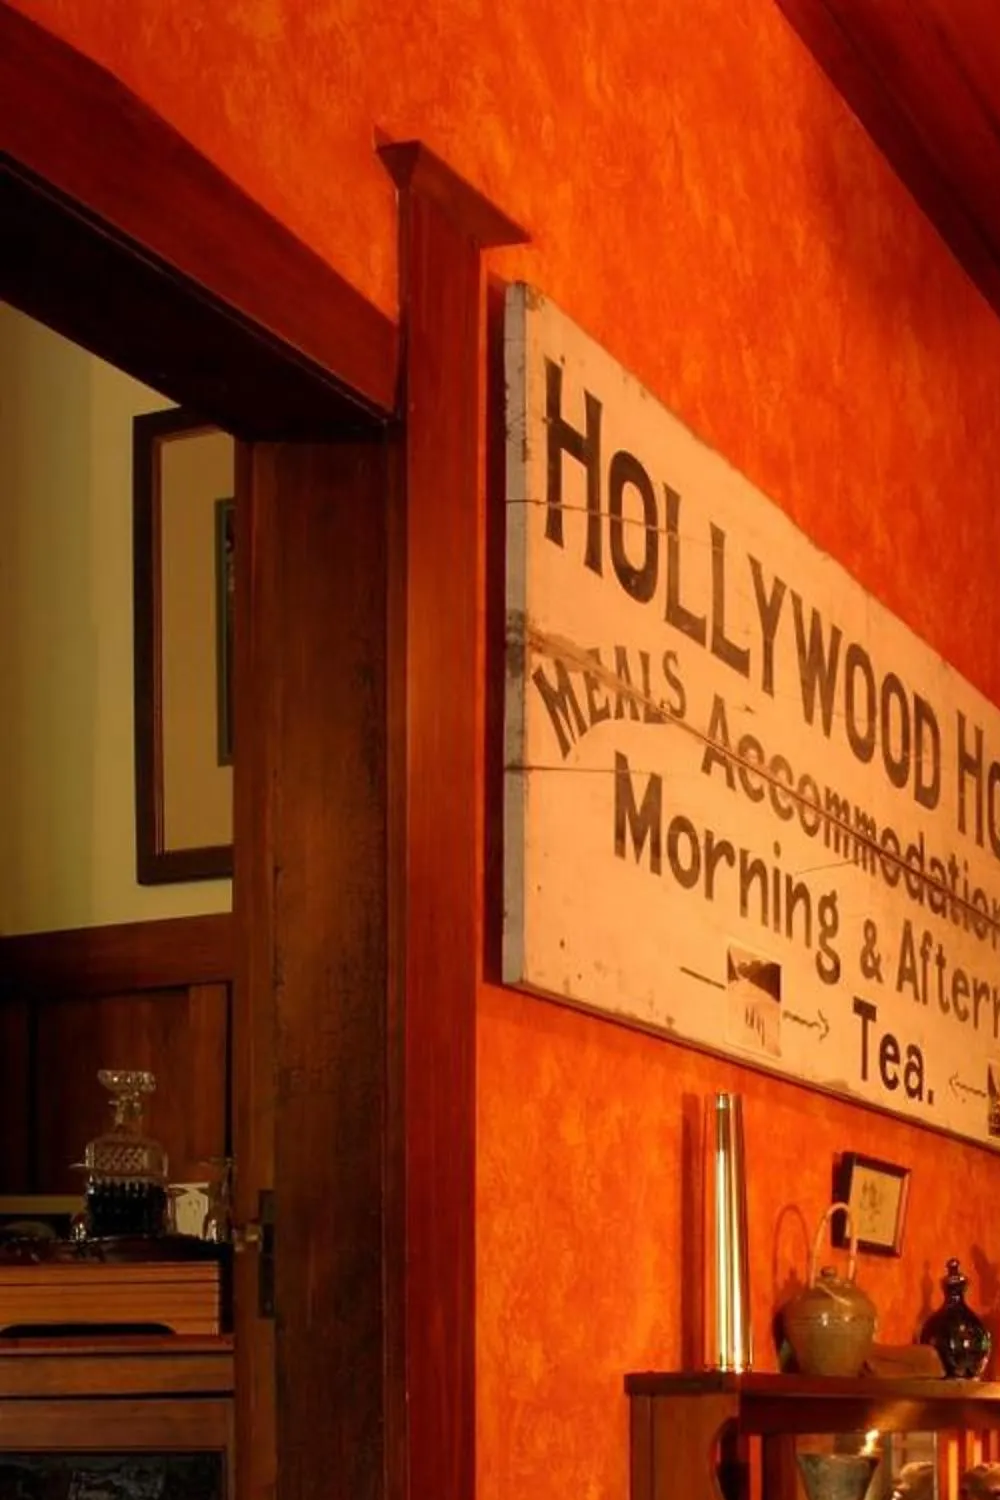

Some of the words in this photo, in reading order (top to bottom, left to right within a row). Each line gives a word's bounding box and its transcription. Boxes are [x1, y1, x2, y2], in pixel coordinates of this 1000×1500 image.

[543, 354, 942, 812] HOLLYWOOD
[531, 644, 687, 761] MEALS
[613, 749, 842, 986] Morning
[859, 917, 885, 984] &
[852, 995, 935, 1106] Tea.
